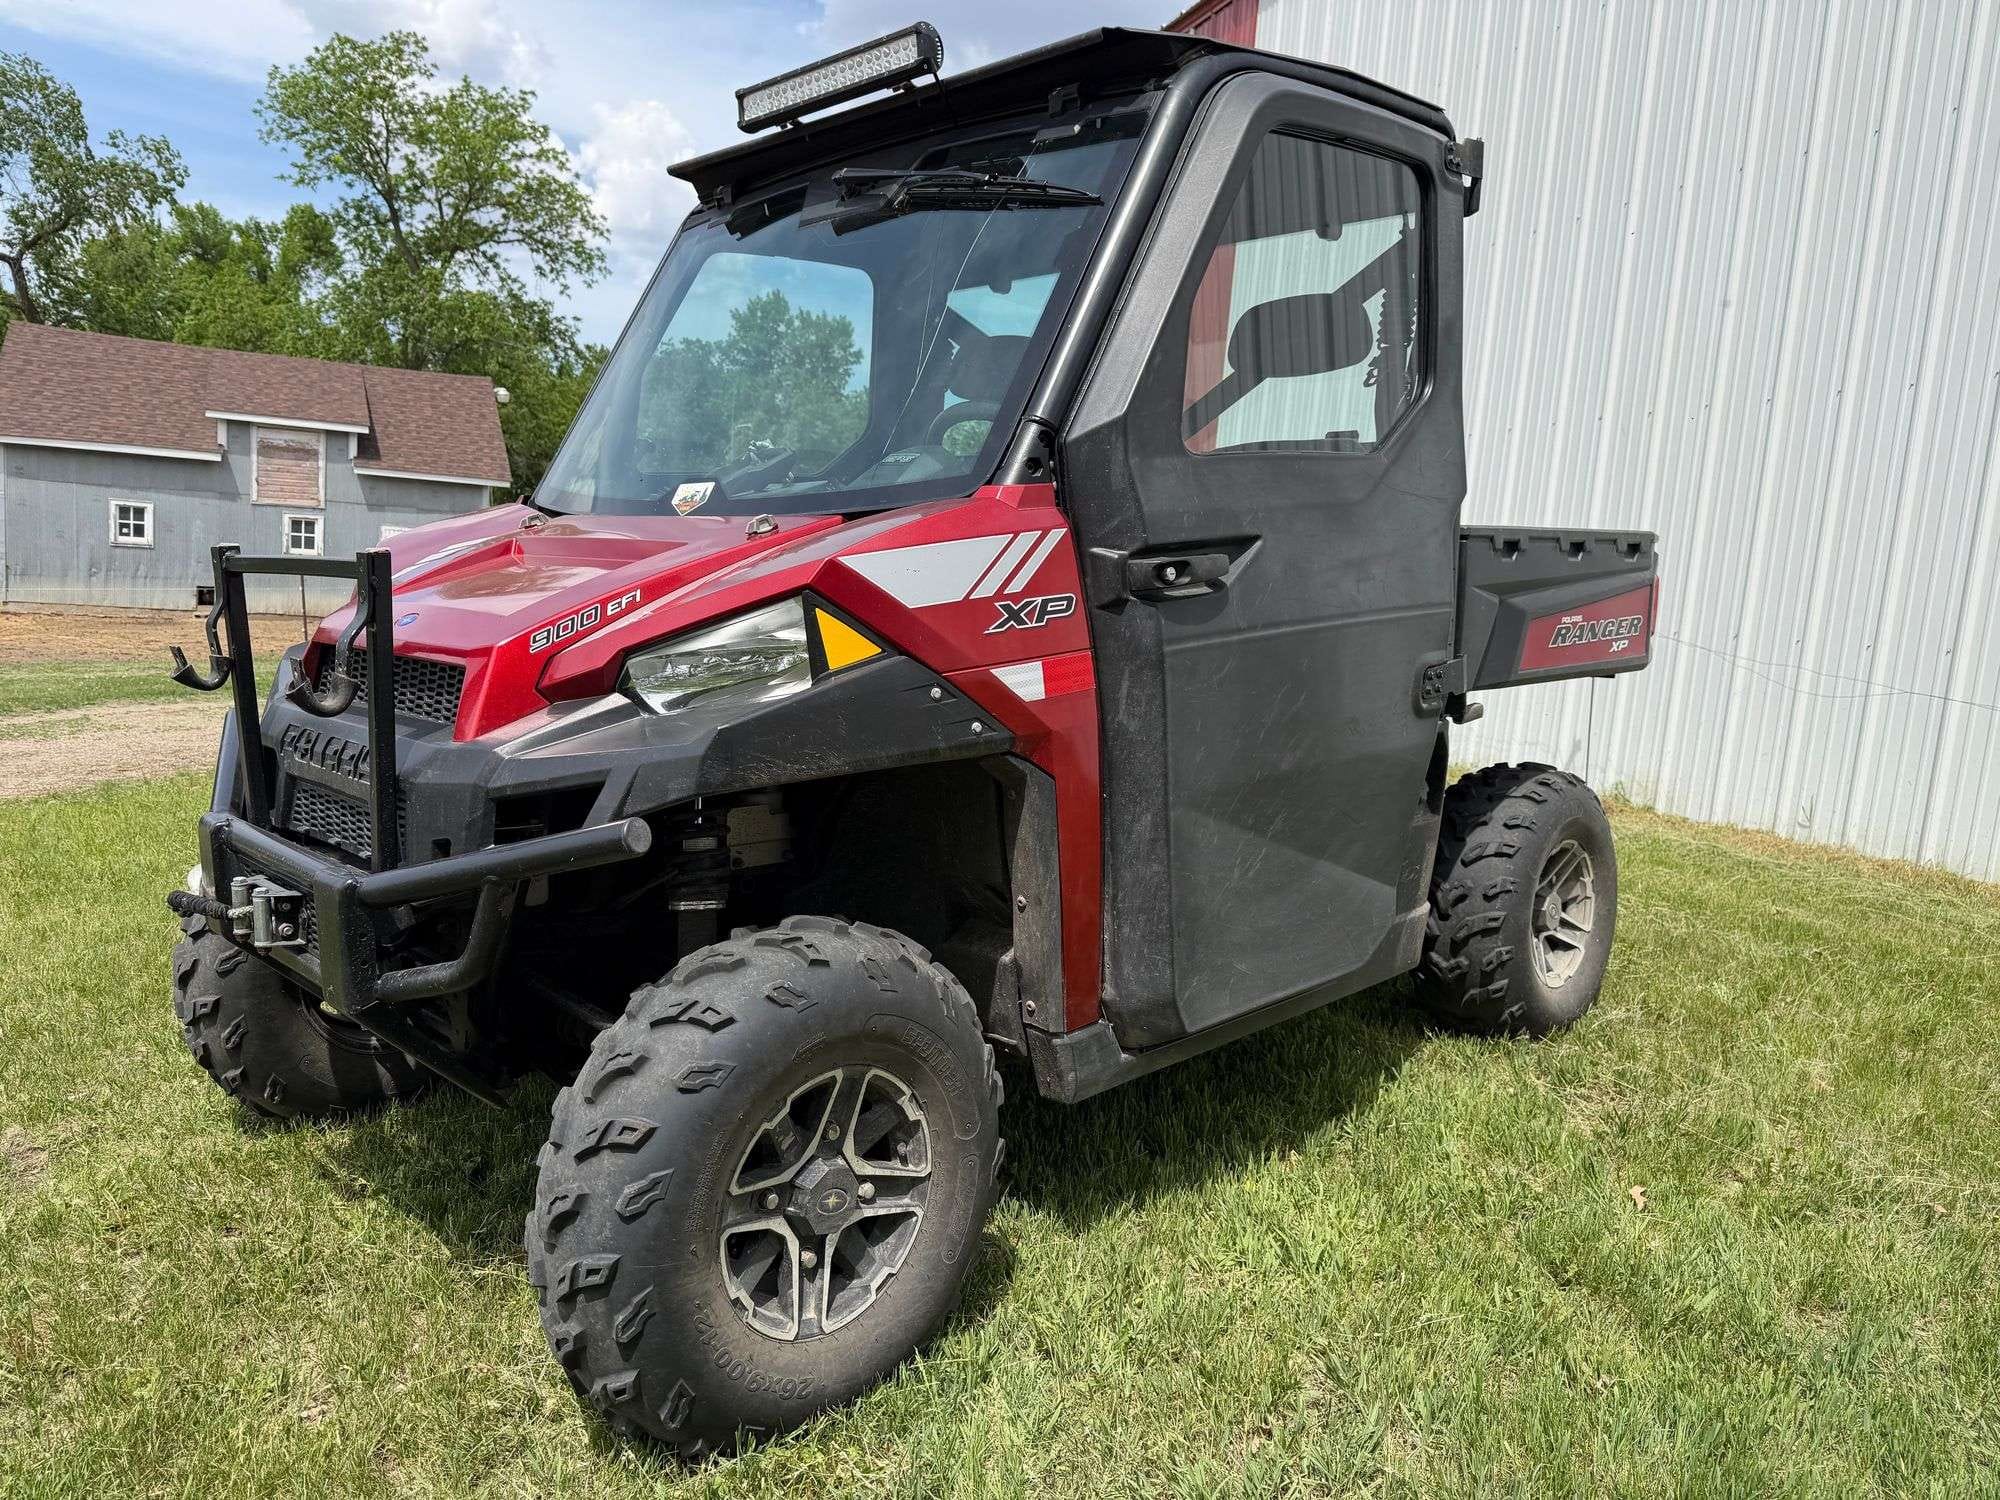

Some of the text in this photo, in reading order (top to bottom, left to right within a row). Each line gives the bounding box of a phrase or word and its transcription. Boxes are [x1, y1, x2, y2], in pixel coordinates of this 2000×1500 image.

[530, 588, 641, 653] 900 EFI
[983, 593, 1076, 634] XP
[1548, 615, 1643, 647] RANGER
[1609, 640, 1628, 652] XP
